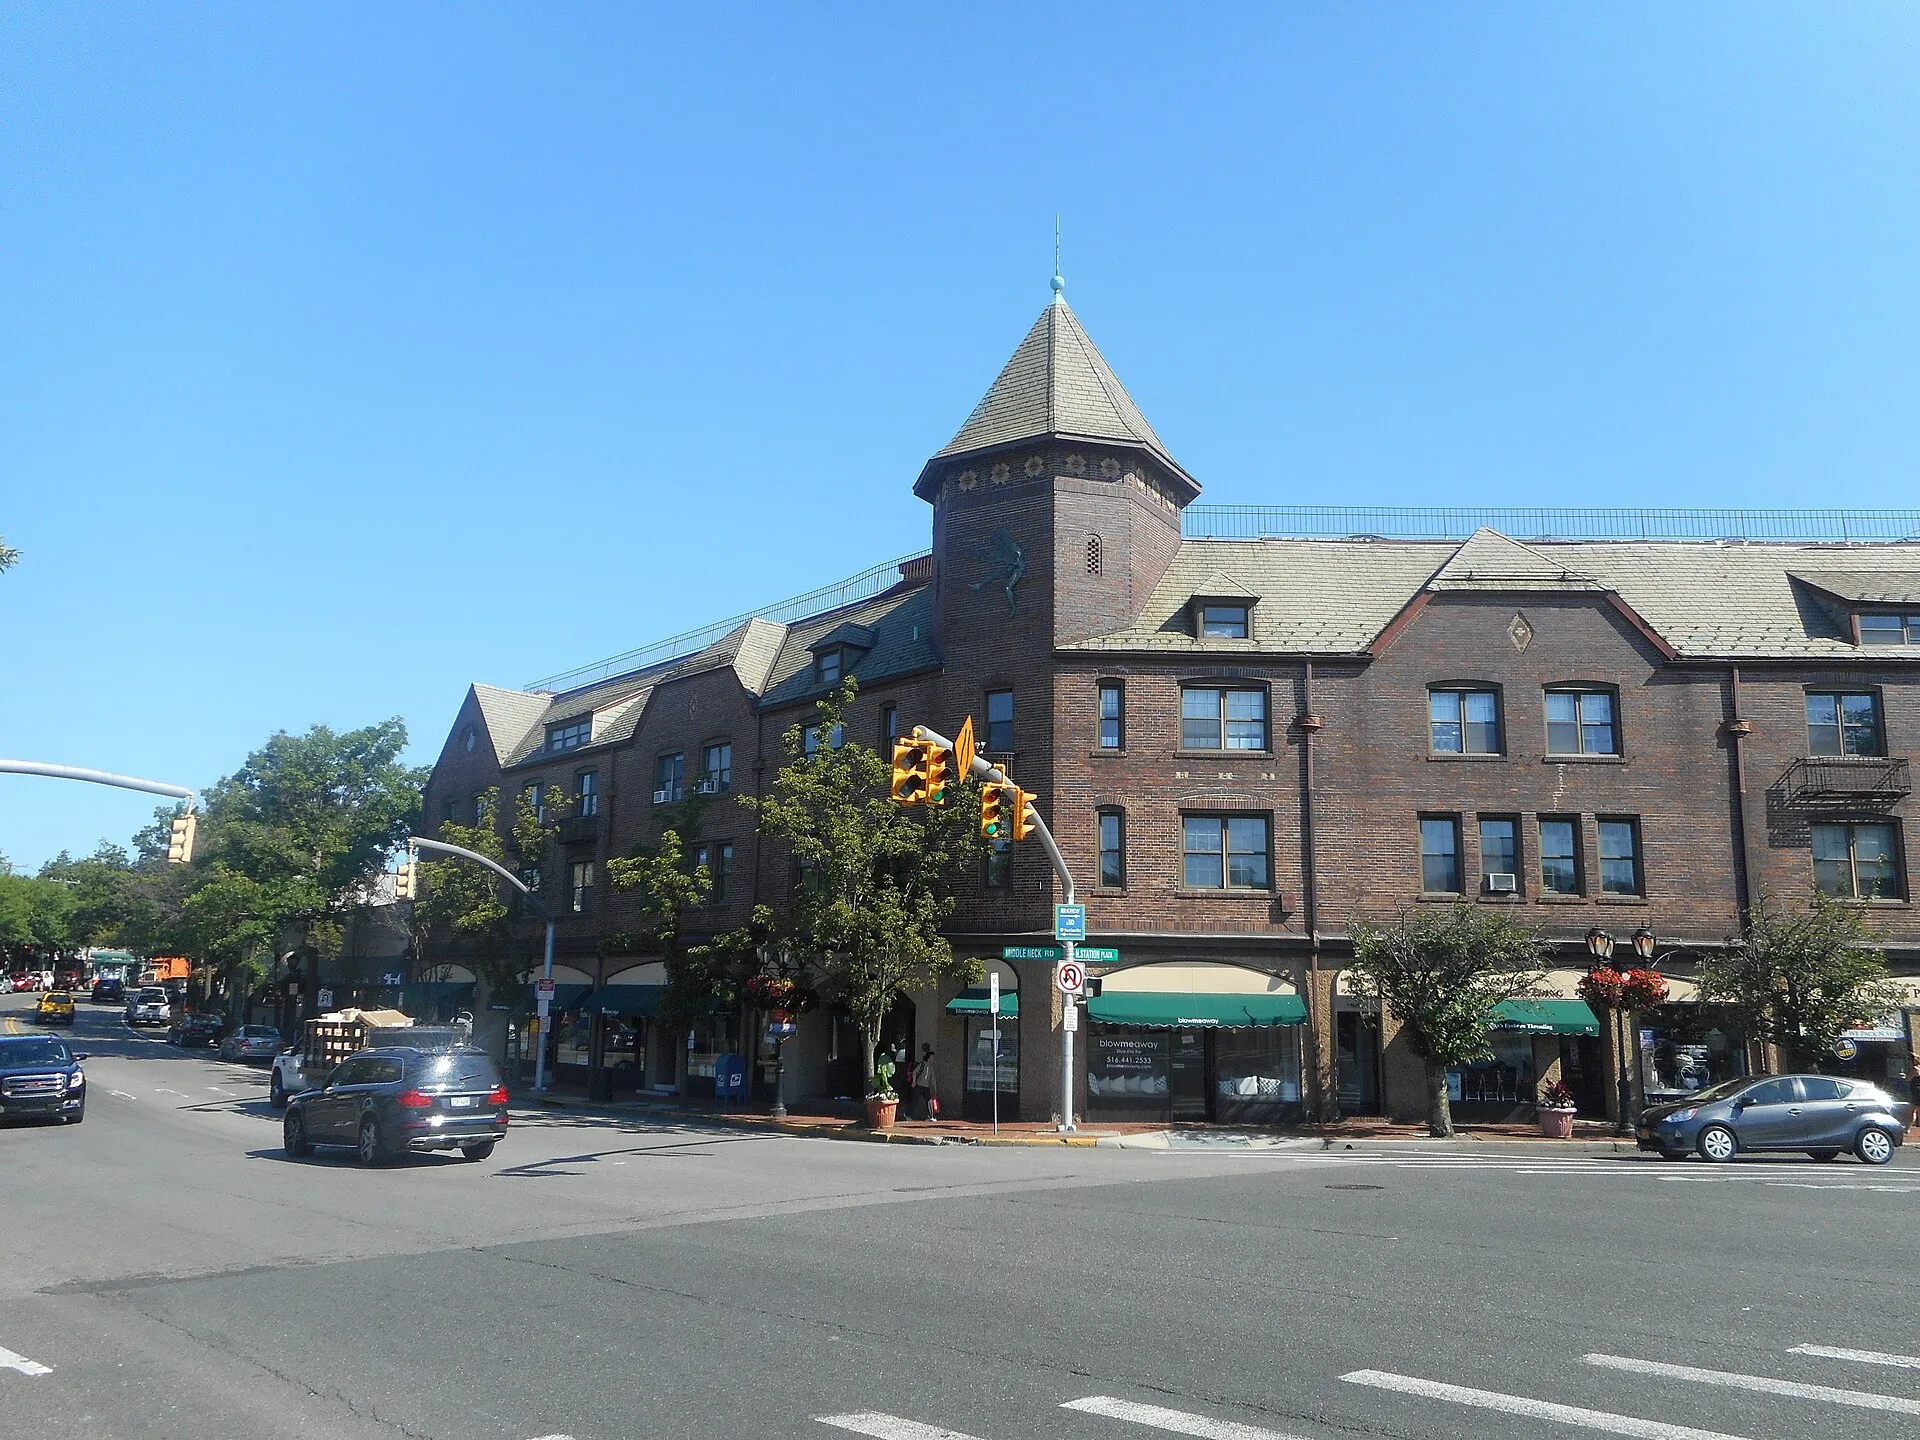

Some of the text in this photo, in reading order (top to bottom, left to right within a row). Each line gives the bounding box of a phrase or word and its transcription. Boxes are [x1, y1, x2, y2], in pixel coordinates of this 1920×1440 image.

[1005, 949, 1055, 958] MIDDLE NECK RD
[1101, 951, 1113, 959] PLAZA
[1099, 1039, 1158, 1050] blowmeaway
[1106, 1056, 1152, 1064] 516.441.2533
